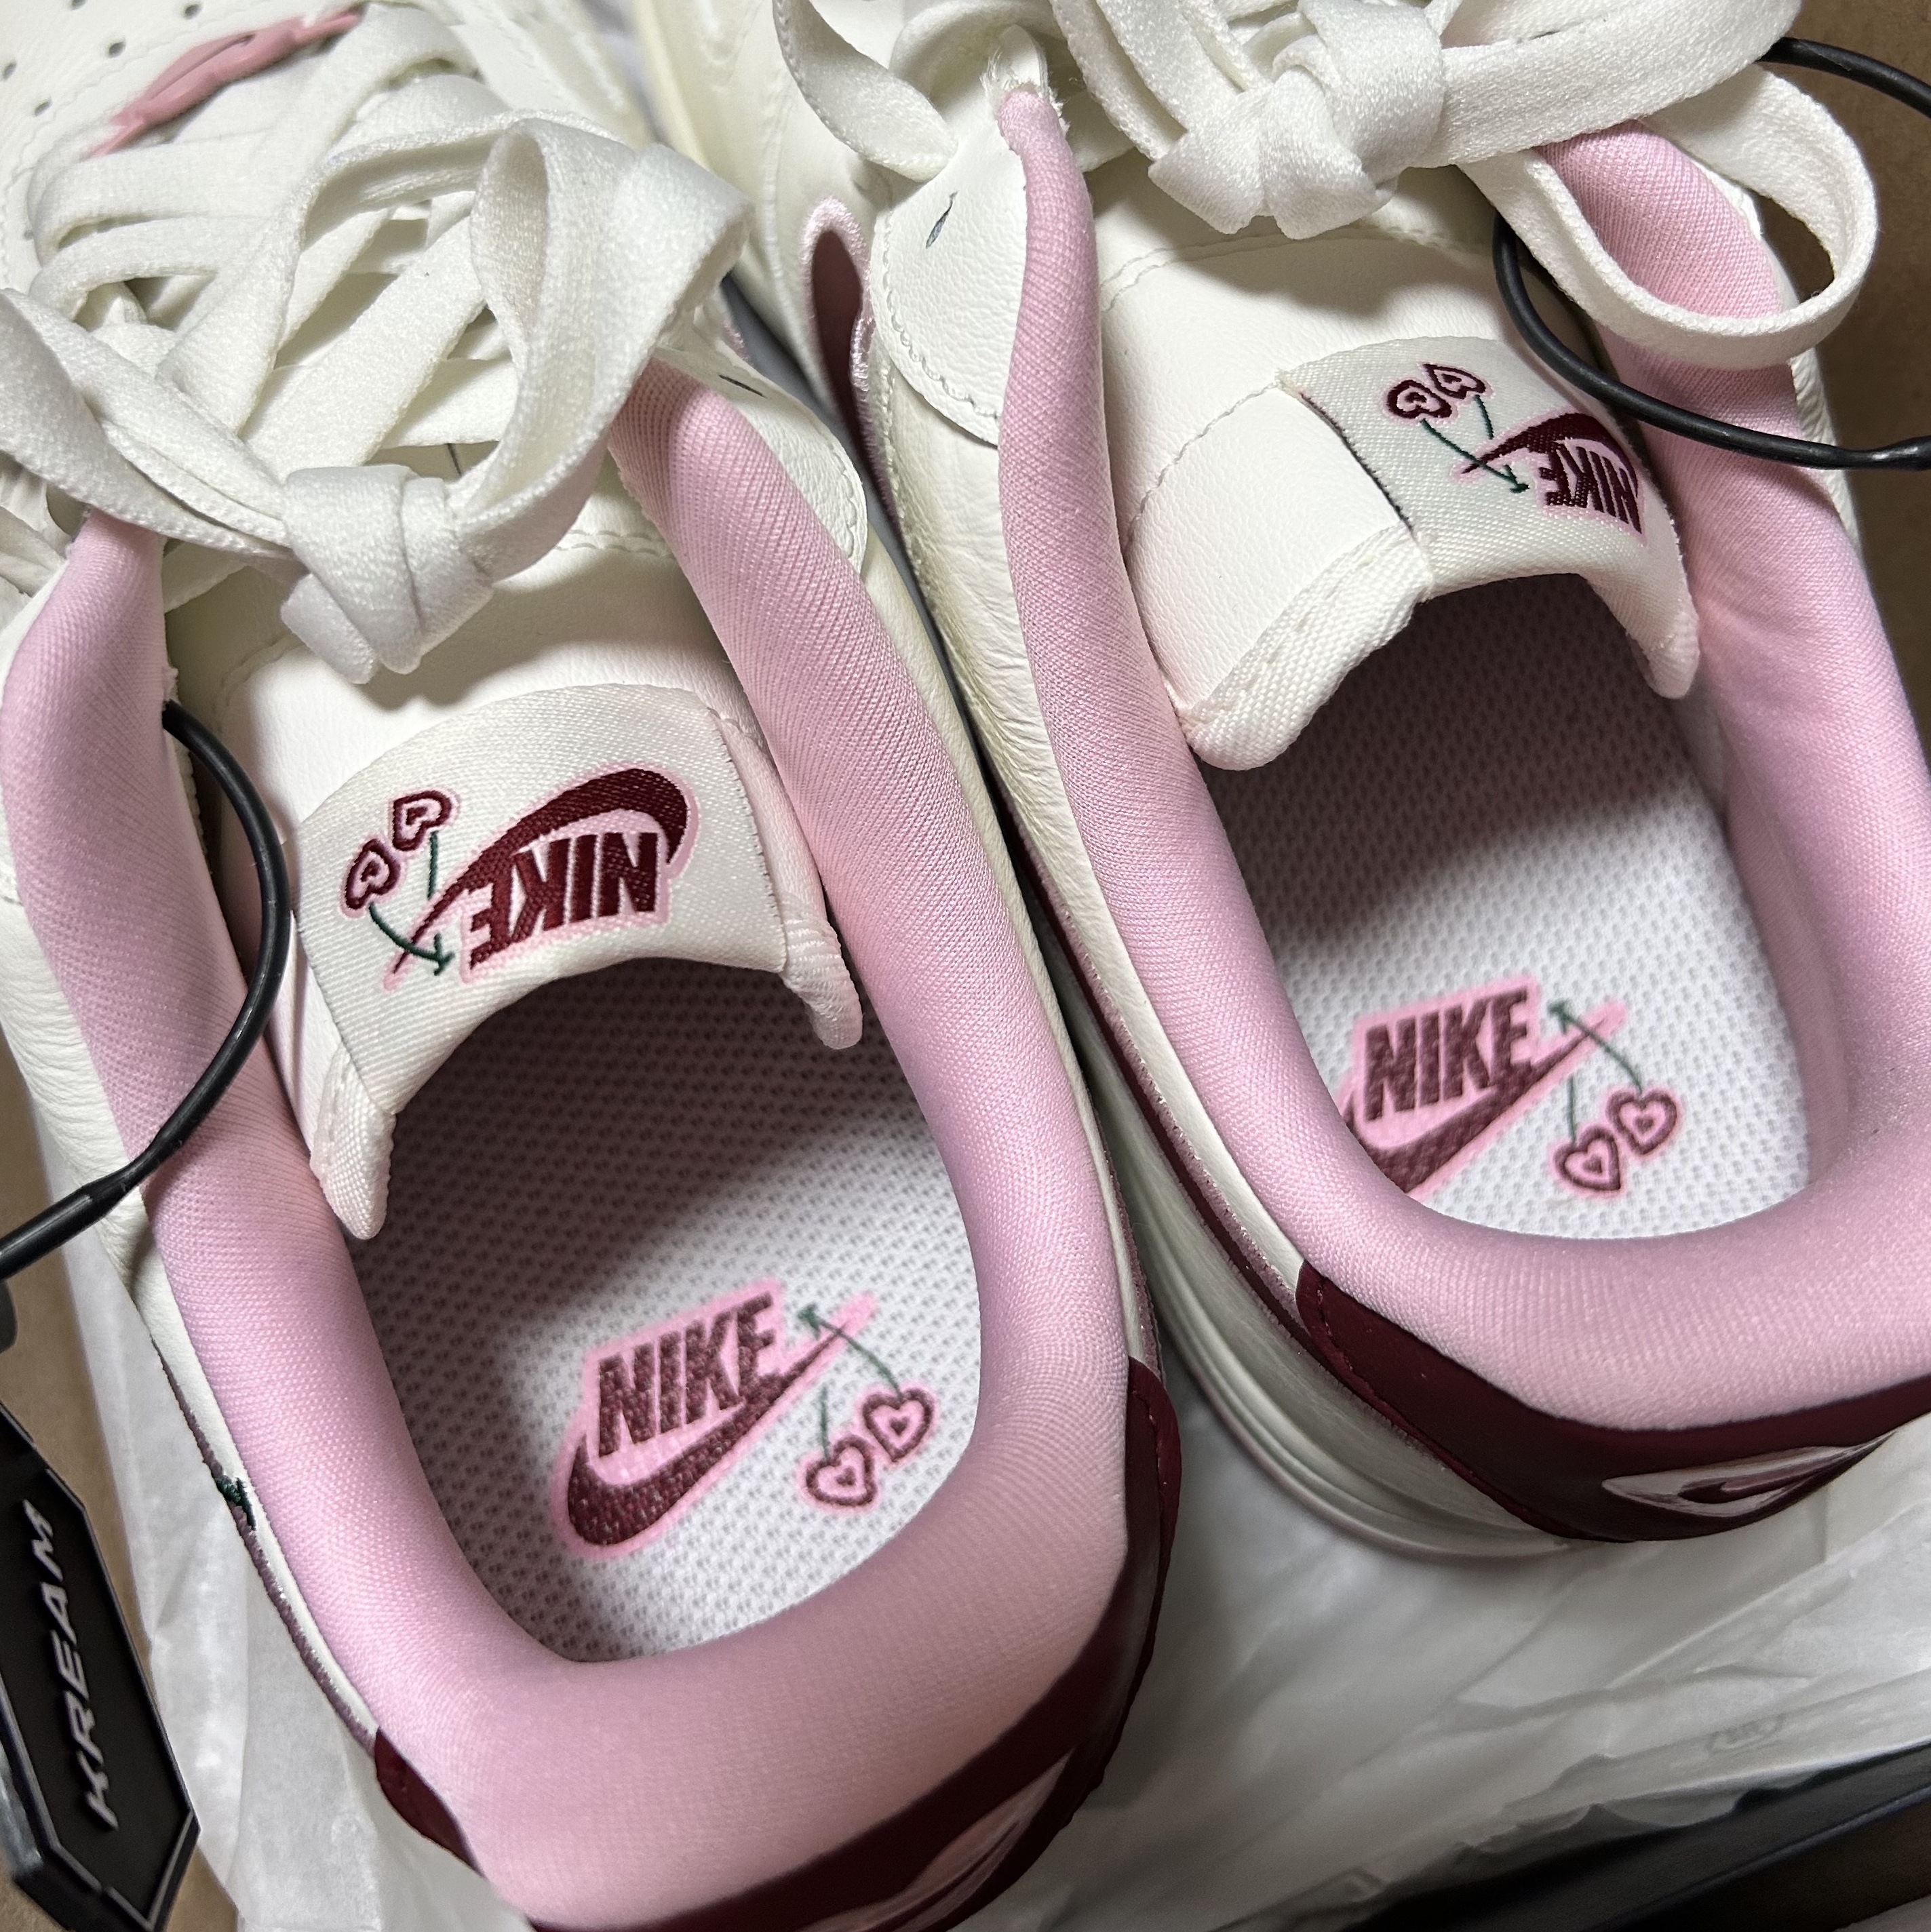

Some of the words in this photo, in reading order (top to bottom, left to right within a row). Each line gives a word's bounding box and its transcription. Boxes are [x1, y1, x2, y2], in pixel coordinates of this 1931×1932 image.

[1538, 441, 1642, 534] NIKE
[470, 832, 658, 970] NIKE
[1363, 987, 1531, 1122] NIKE
[599, 1291, 779, 1457] NIKE
[22, 1499, 118, 1830] KREAM
